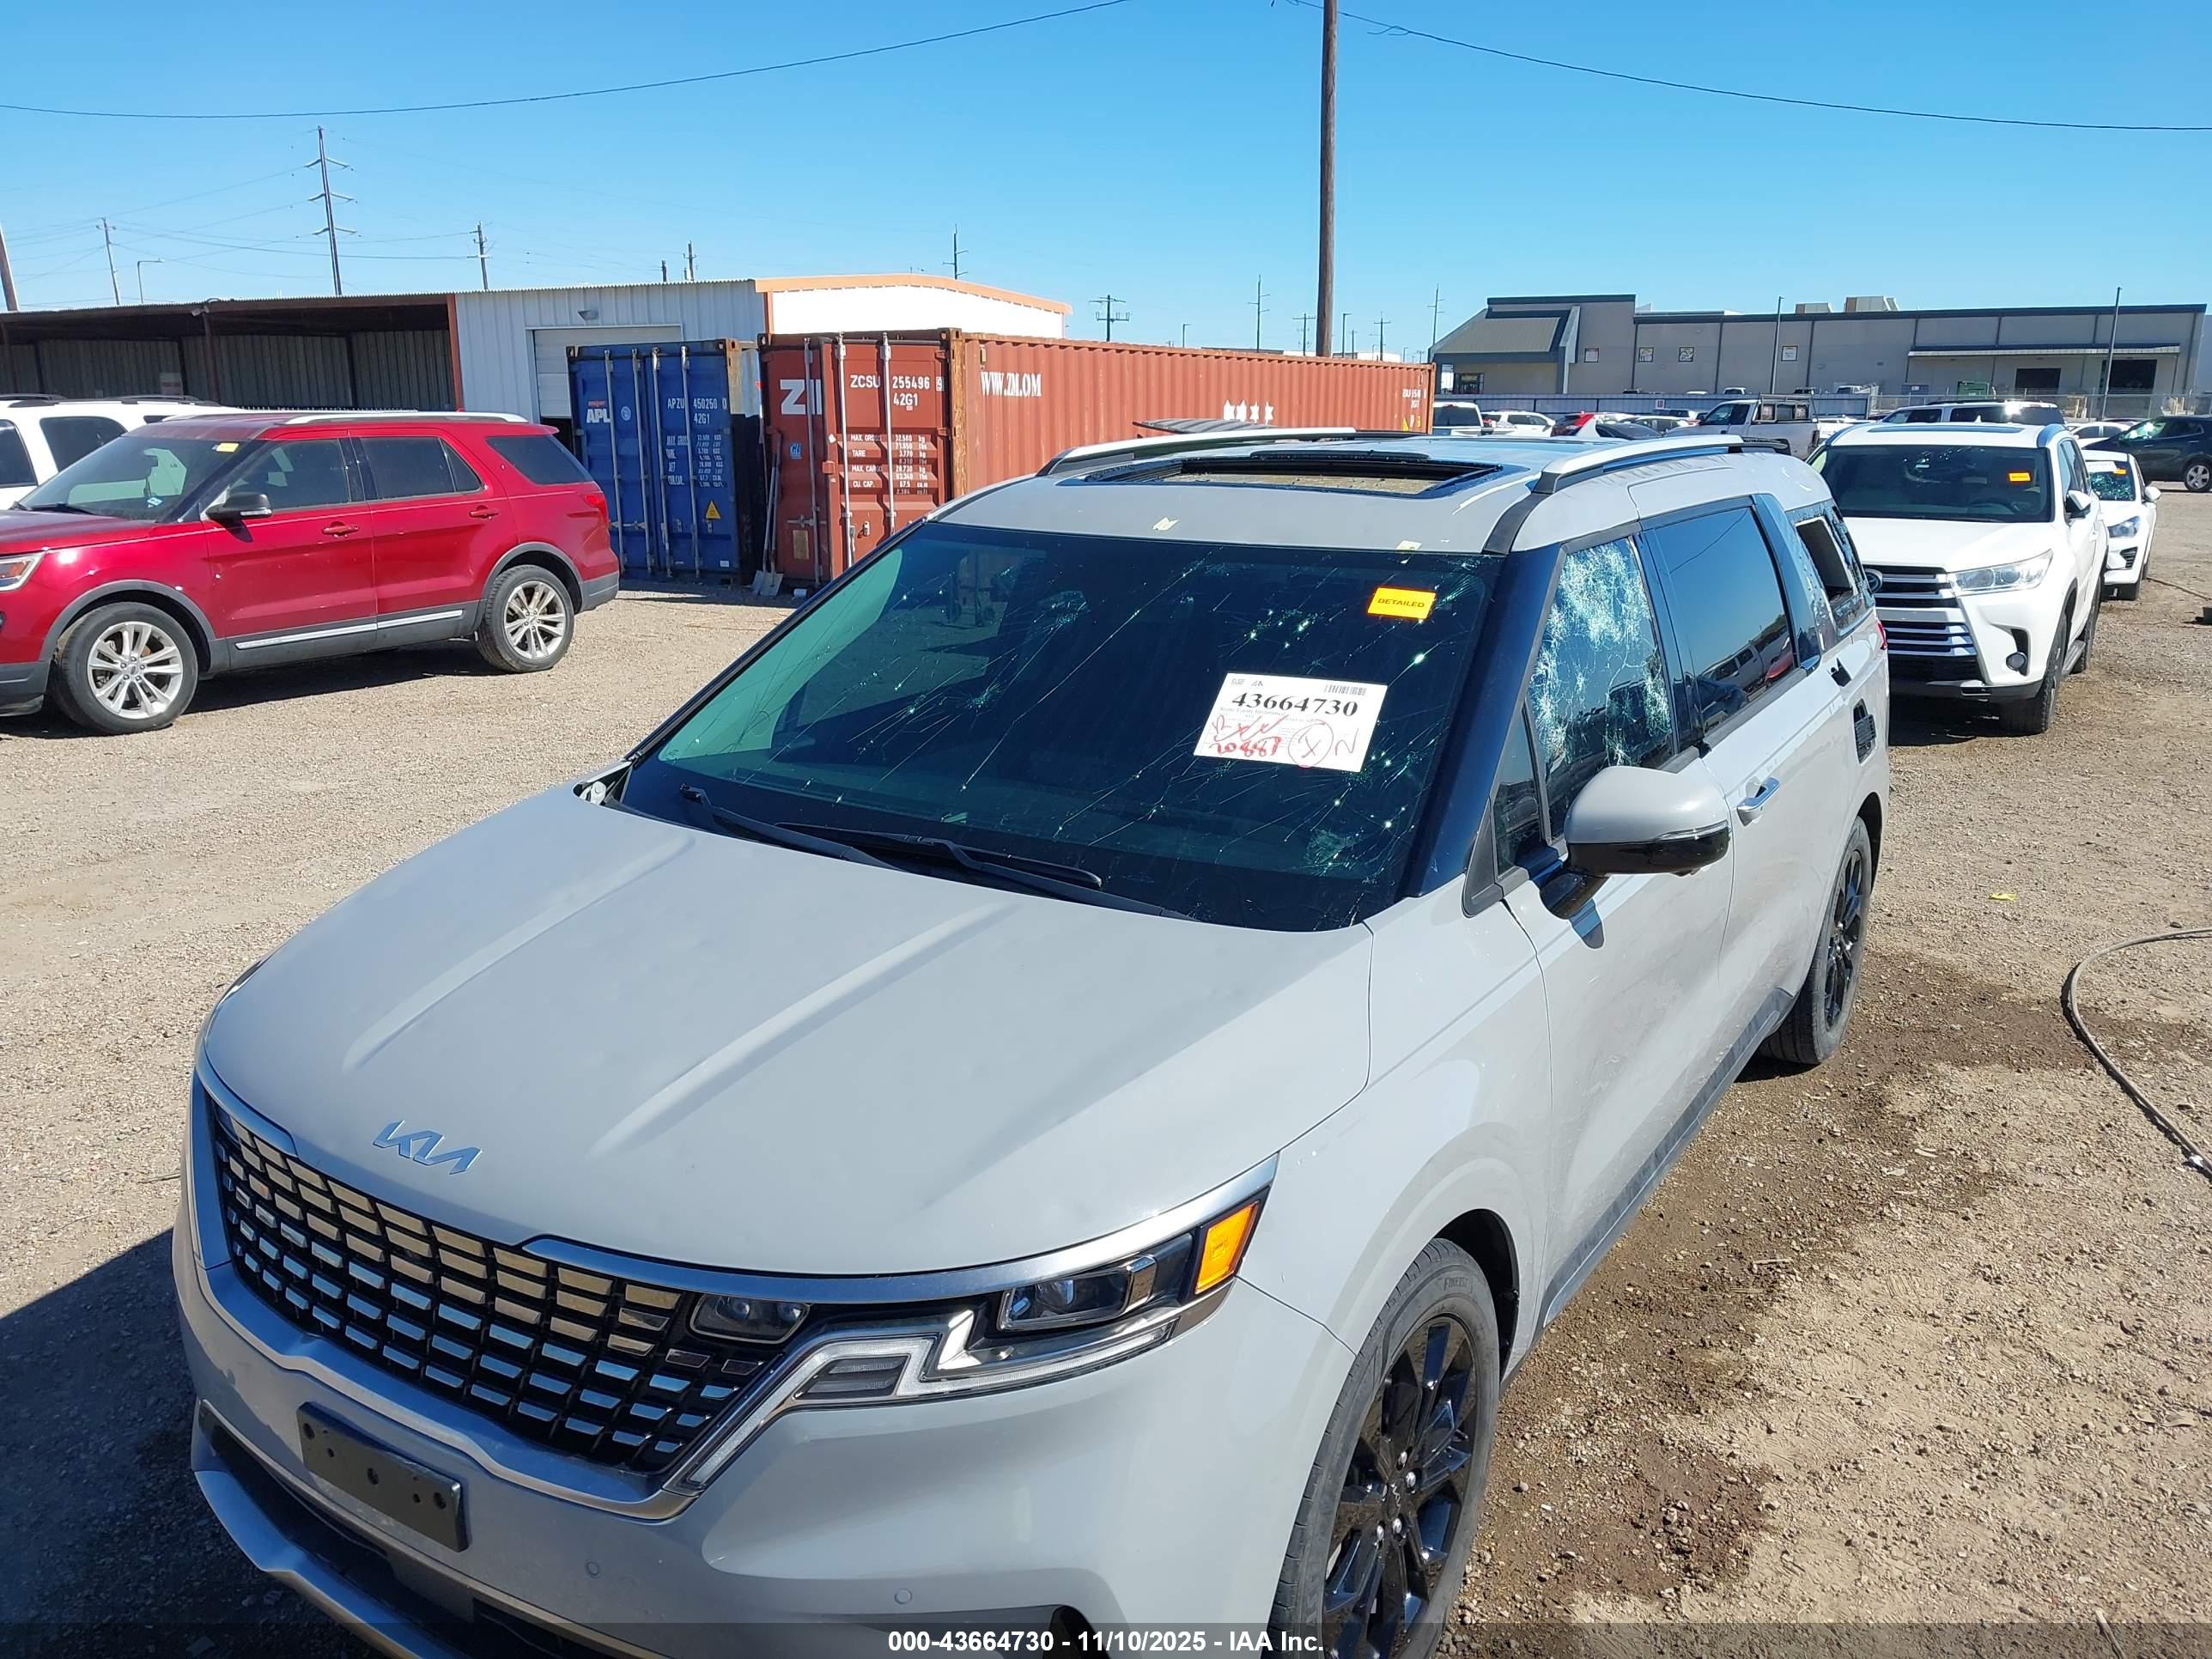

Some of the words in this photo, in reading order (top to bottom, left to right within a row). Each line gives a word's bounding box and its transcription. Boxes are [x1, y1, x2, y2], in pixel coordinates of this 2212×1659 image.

[850, 374, 881, 388] ZCSU
[892, 376, 930, 390] 255496
[667, 398, 684, 410] APZU
[693, 398, 717, 410] 450250
[893, 393, 918, 406] 42G1
[586, 408, 611, 423] APL
[694, 413, 710, 425] 42G1
[852, 449, 866, 458] TARE
[1377, 598, 1425, 608] DETAILED
[1231, 692, 1358, 717] 43664730
